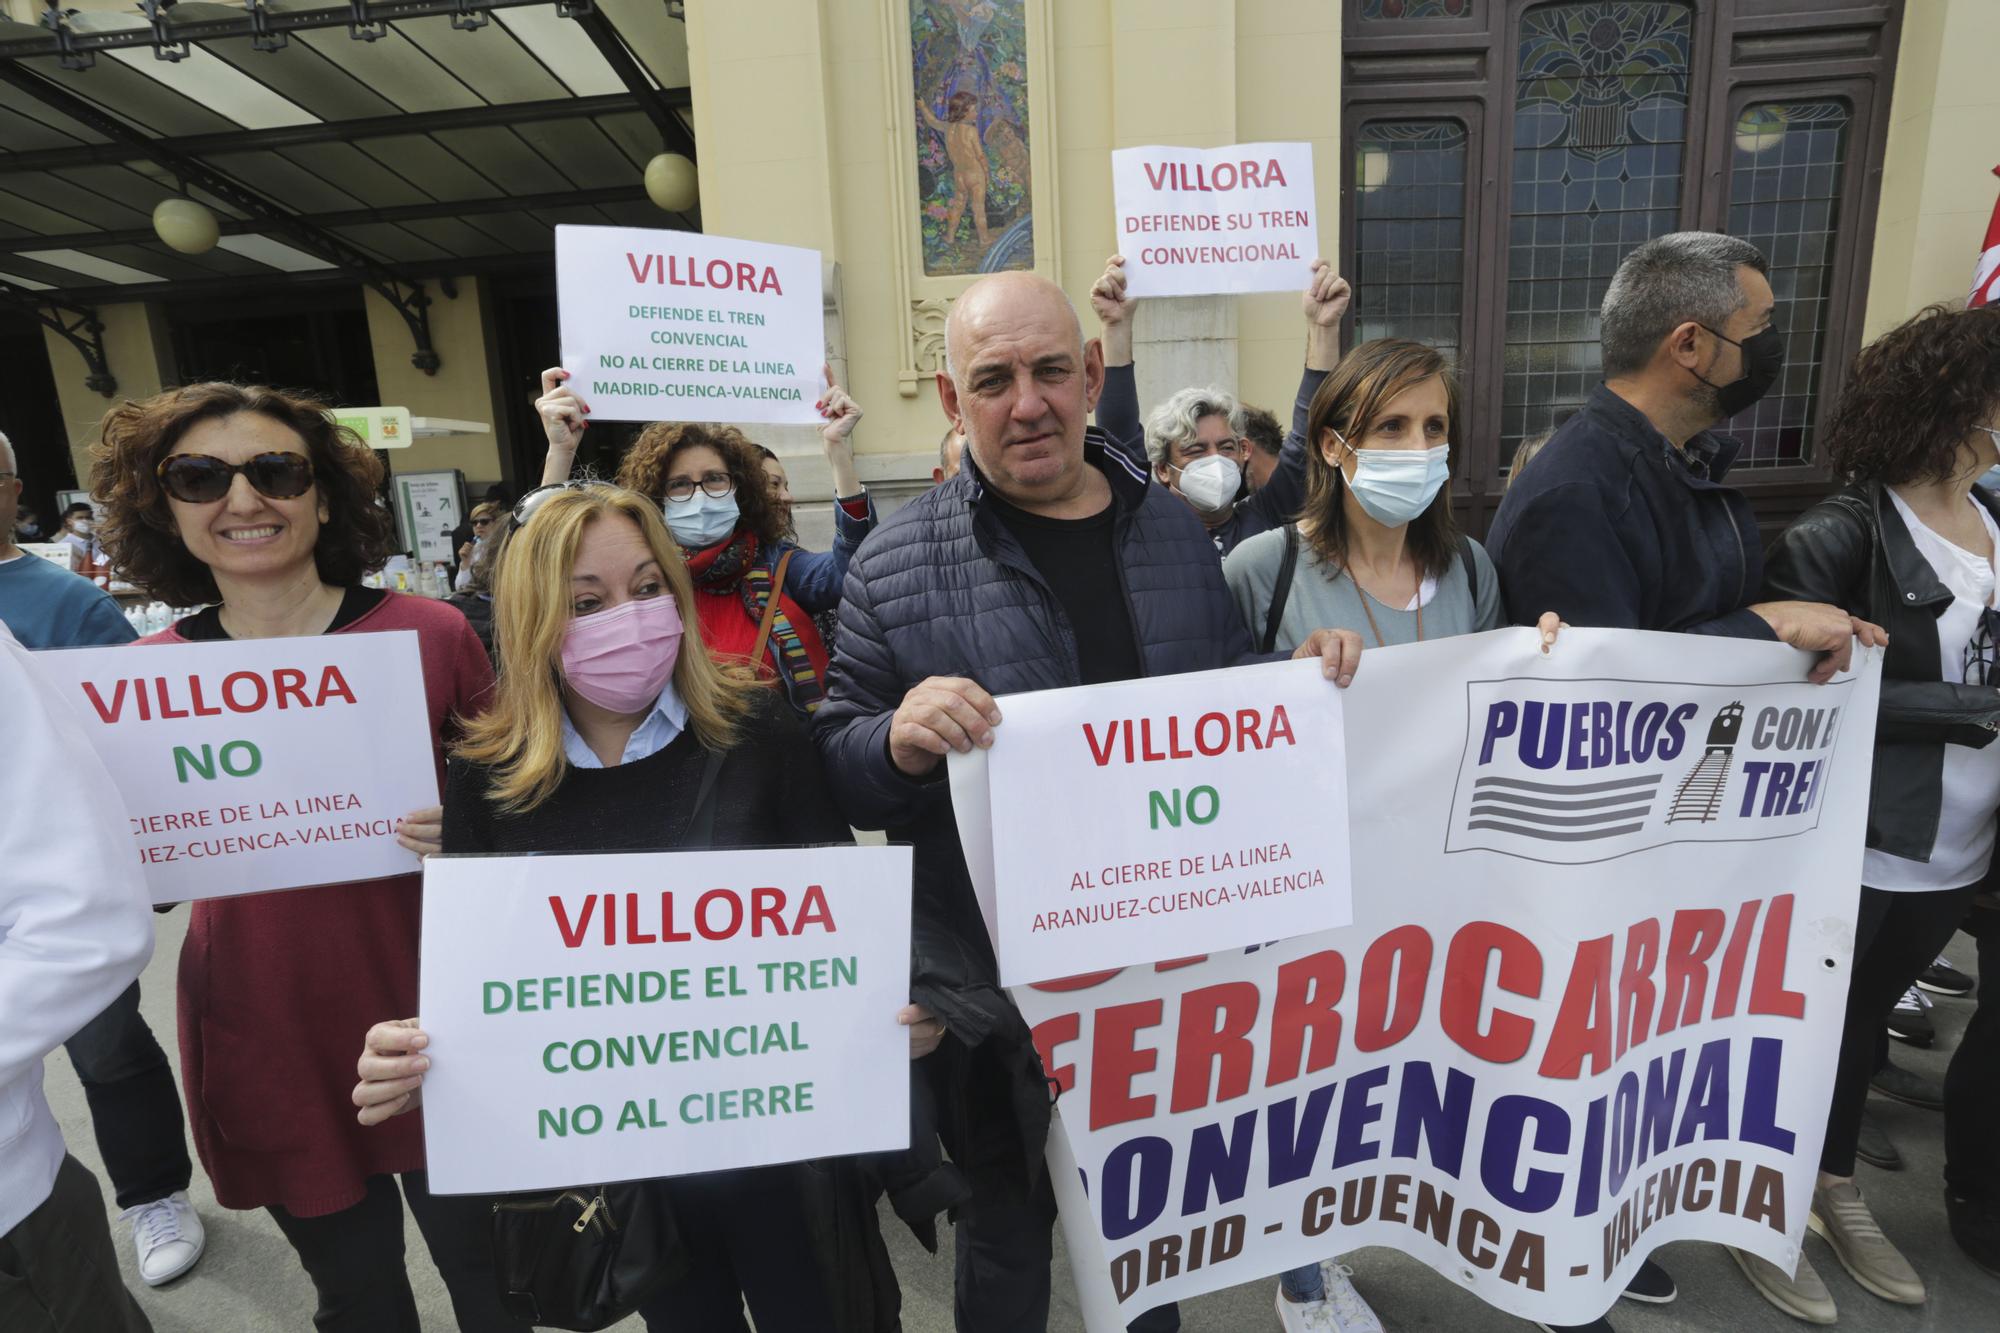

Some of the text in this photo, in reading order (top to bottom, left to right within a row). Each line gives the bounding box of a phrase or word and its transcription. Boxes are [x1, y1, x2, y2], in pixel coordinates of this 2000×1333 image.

[1144, 159, 1287, 192] VILLORA
[1126, 211, 1308, 233] DEFIENDE SU TREN
[627, 253, 782, 296] VILLORA
[1141, 243, 1300, 265] CONVENCIONAL
[629, 305, 765, 326] DEFIENDE EL TREN
[651, 331, 748, 348] CONVENCIAL
[600, 355, 795, 375] NO AL CIERRE DE LA LINEA
[594, 382, 802, 400] MADRID-CUENCA-VALENCIA
[81, 666, 357, 723] VILLORA
[1082, 705, 1296, 766] VILLORA
[1479, 700, 1699, 771] PUEBLOS
[1752, 706, 1824, 750] CON
[173, 740, 262, 783] NO
[220, 806, 252, 824] DE
[260, 802, 288, 819] LA
[296, 794, 362, 814] LINEA
[1149, 785, 1220, 830] NO
[1071, 843, 1291, 891] AL CIERRE DE LA LINEA
[548, 885, 836, 948] VILLORA
[1032, 869, 1324, 933] ARANJUEZ-CUENCA-VALENCIA
[483, 956, 857, 1014] DEFIENDE EL TREN
[1031, 893, 1805, 1131] FERROCARRIL
[543, 1022, 808, 1073] CONVENCIAL
[538, 1082, 813, 1139] NO AL CIERRE
[1079, 1037, 1796, 1240] ONVENCIONAL
[1111, 1212, 1246, 1305] DRID
[1301, 1173, 1546, 1292] CUENCA
[1603, 1158, 1786, 1281] VALENCIA
